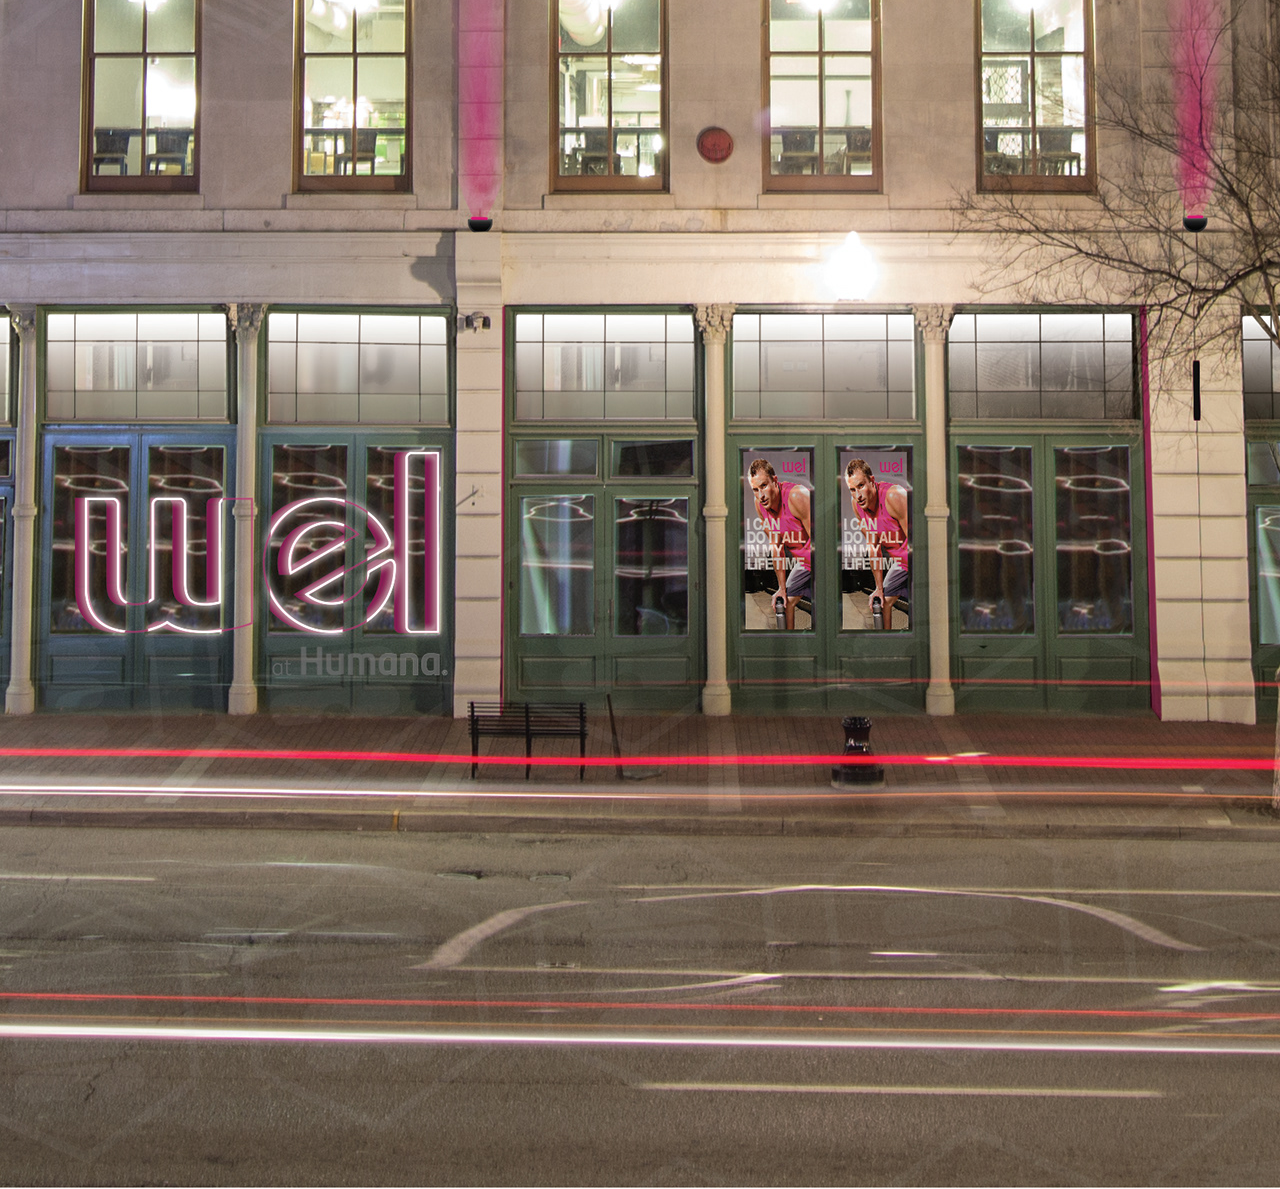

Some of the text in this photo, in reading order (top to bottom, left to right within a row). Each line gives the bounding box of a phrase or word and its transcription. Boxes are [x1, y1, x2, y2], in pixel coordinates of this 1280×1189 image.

[782, 457, 806, 473] wel
[879, 458, 903, 473] wel
[753, 517, 780, 531] CAN
[850, 517, 877, 531] CAN
[73, 449, 443, 635] wel
[747, 531, 806, 544] DO IT ALL
[844, 531, 903, 544] DO IT ALL
[747, 544, 783, 557] IN MY
[844, 544, 880, 557] IN MY
[747, 557, 805, 571] LIFETIME
[844, 557, 902, 571] LIFETIME
[271, 646, 449, 677] at Humana.
